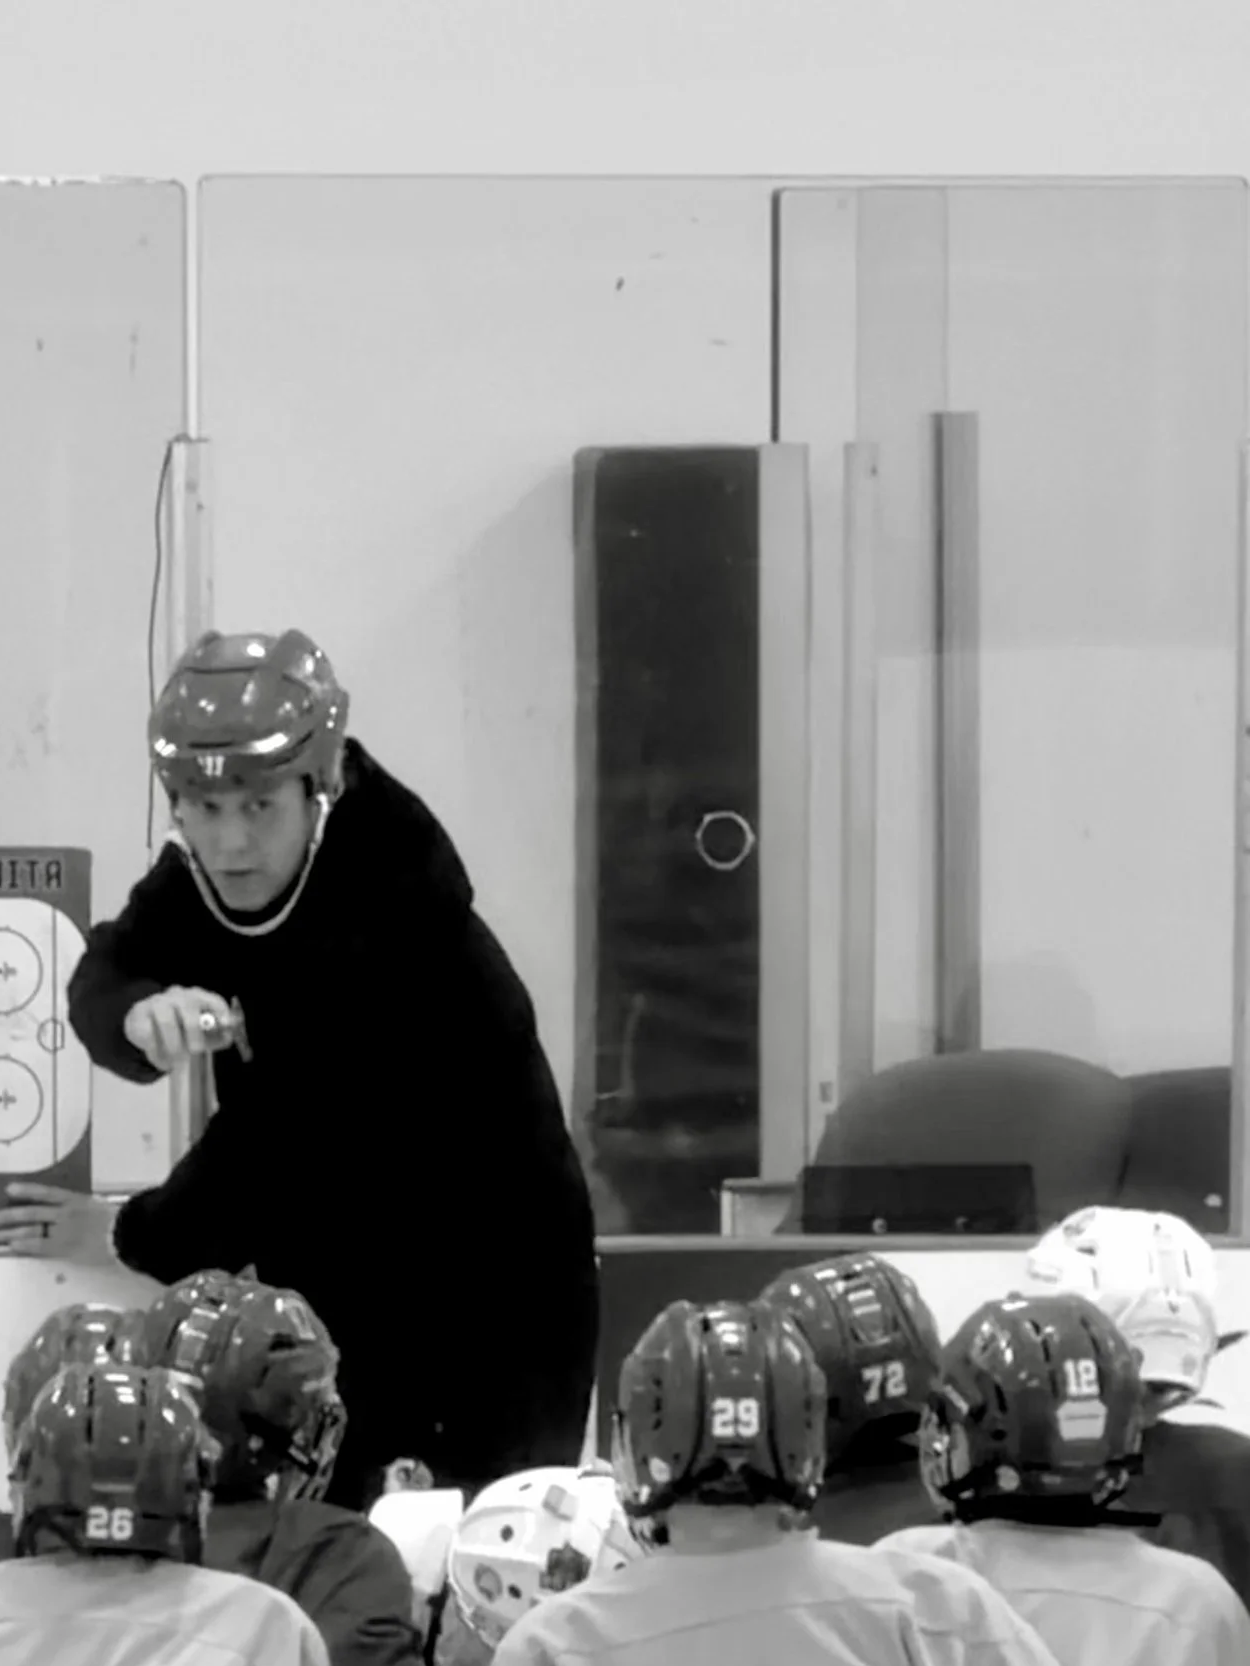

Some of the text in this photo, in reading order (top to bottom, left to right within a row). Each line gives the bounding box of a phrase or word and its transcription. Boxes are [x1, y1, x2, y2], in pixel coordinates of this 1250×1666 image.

[861, 1361, 907, 1403] 72
[711, 1397, 760, 1437] 29
[86, 1505, 133, 1540] 26
